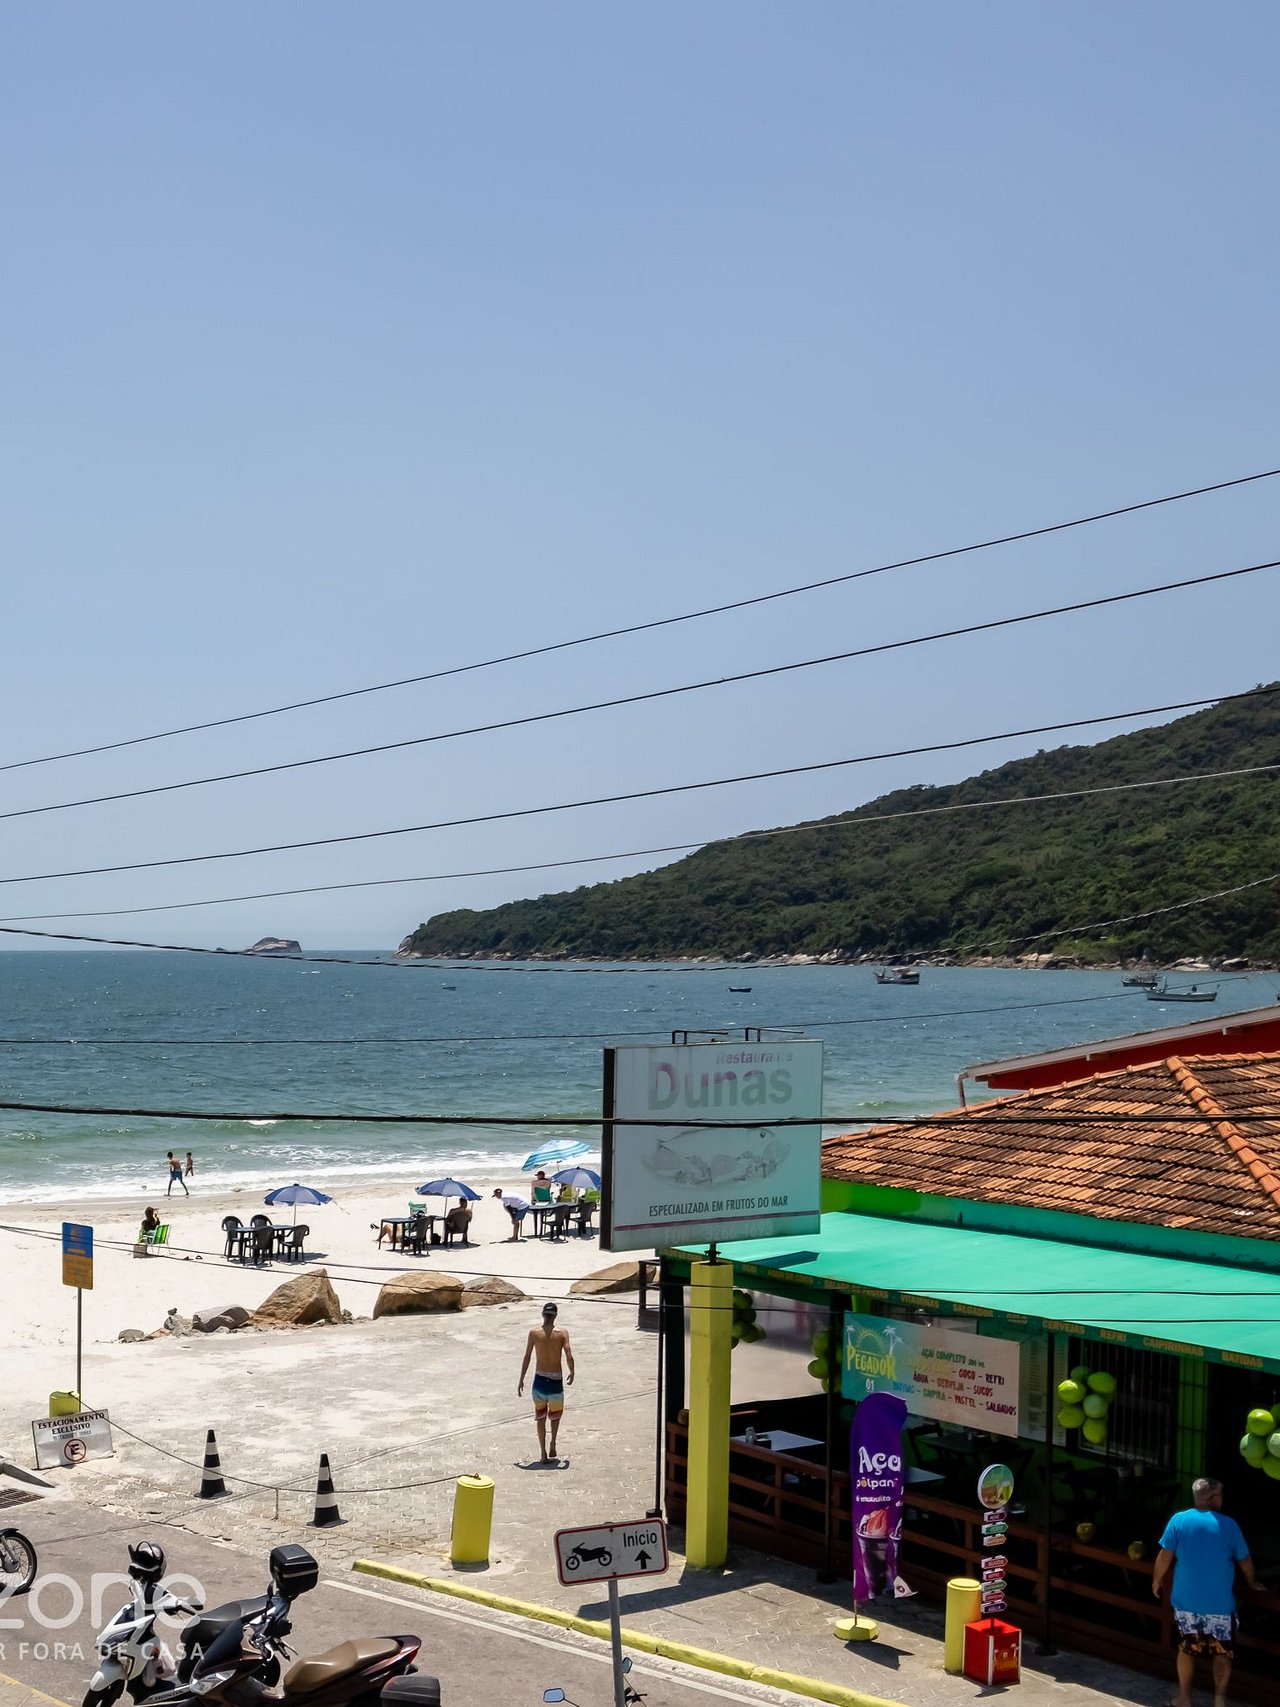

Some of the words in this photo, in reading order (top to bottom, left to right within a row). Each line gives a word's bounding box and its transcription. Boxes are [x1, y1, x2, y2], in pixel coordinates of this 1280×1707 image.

[648, 1062, 793, 1111] Dunas
[649, 1200, 710, 1217] ESPECIALIZADA
[712, 1201, 724, 1213] EM
[726, 1197, 756, 1211] FRUTOS
[758, 1196, 769, 1209] DO
[771, 1195, 788, 1207] MAR
[952, 1303, 994, 1318] SALGADOS
[1042, 1319, 1085, 1335] CERVEJAS
[1100, 1328, 1127, 1343] REFRI
[1143, 1336, 1204, 1357] CAIPIRINHAS
[1222, 1350, 1264, 1368] BATIDAS
[846, 1344, 897, 1381] PEGADOR
[937, 1377, 964, 1391] CERVEJA
[973, 1384, 993, 1397] SUCOS
[958, 1368, 976, 1380] COCO
[985, 1373, 1005, 1386] REFRI
[954, 1394, 976, 1408] PASTEL
[985, 1401, 1017, 1416] SALGADOS
[38, 1412, 104, 1429] ESTACIONAMENTO
[52, 1422, 90, 1434] EXCLUSIVO
[623, 1529, 658, 1547] Início
